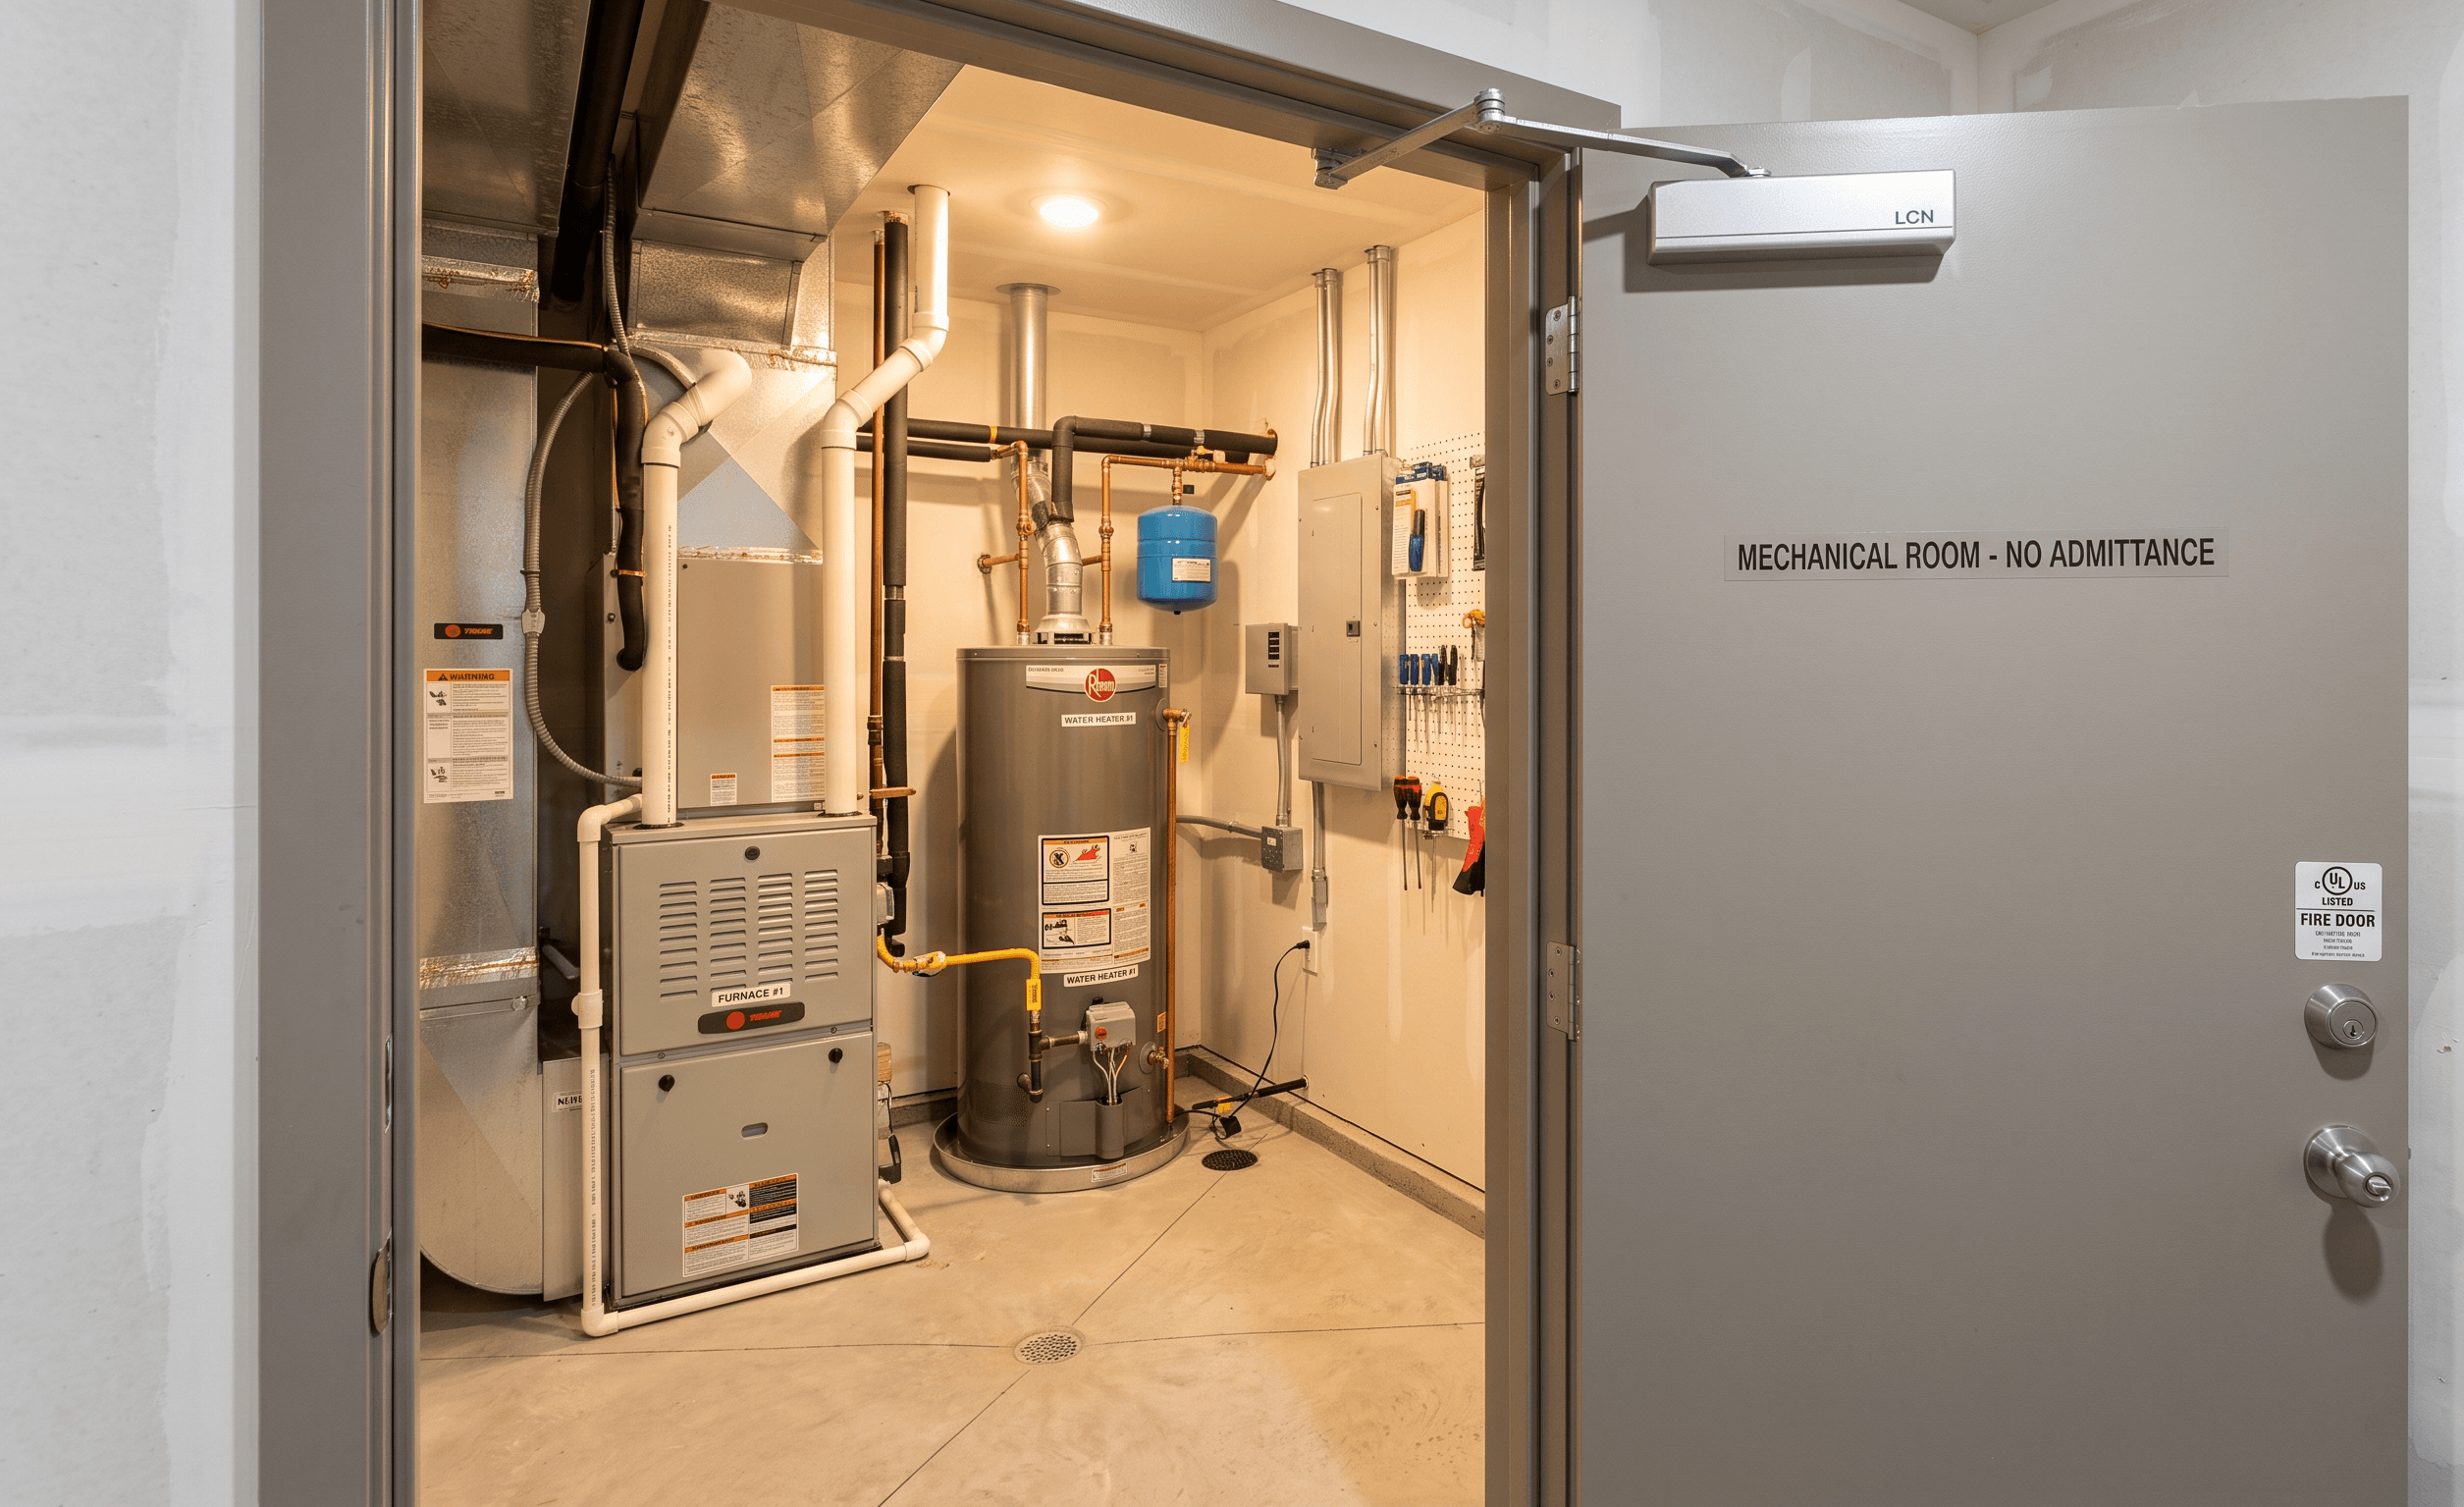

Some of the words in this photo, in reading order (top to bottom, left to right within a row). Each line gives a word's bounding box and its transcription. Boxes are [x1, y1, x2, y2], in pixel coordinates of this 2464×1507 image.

[1895, 209, 1934, 225] LCN
[1737, 542, 1898, 570] MECHANICAL
[1905, 540, 1981, 569] ROOM
[2006, 539, 2042, 568] NO
[2049, 537, 2216, 568] ADMITTANCE
[1064, 716, 1094, 725] WATER
[1096, 715, 1125, 724] HEATER
[2353, 882, 2366, 890] US
[2322, 896, 2354, 906] LISTED
[2300, 912, 2331, 927] FIRE
[2335, 914, 2376, 928] DOOR
[1066, 974, 1096, 984] WATER
[1098, 969, 1128, 981] HEATER
[718, 988, 770, 1003] FURNACE
[773, 987, 783, 996] #1
